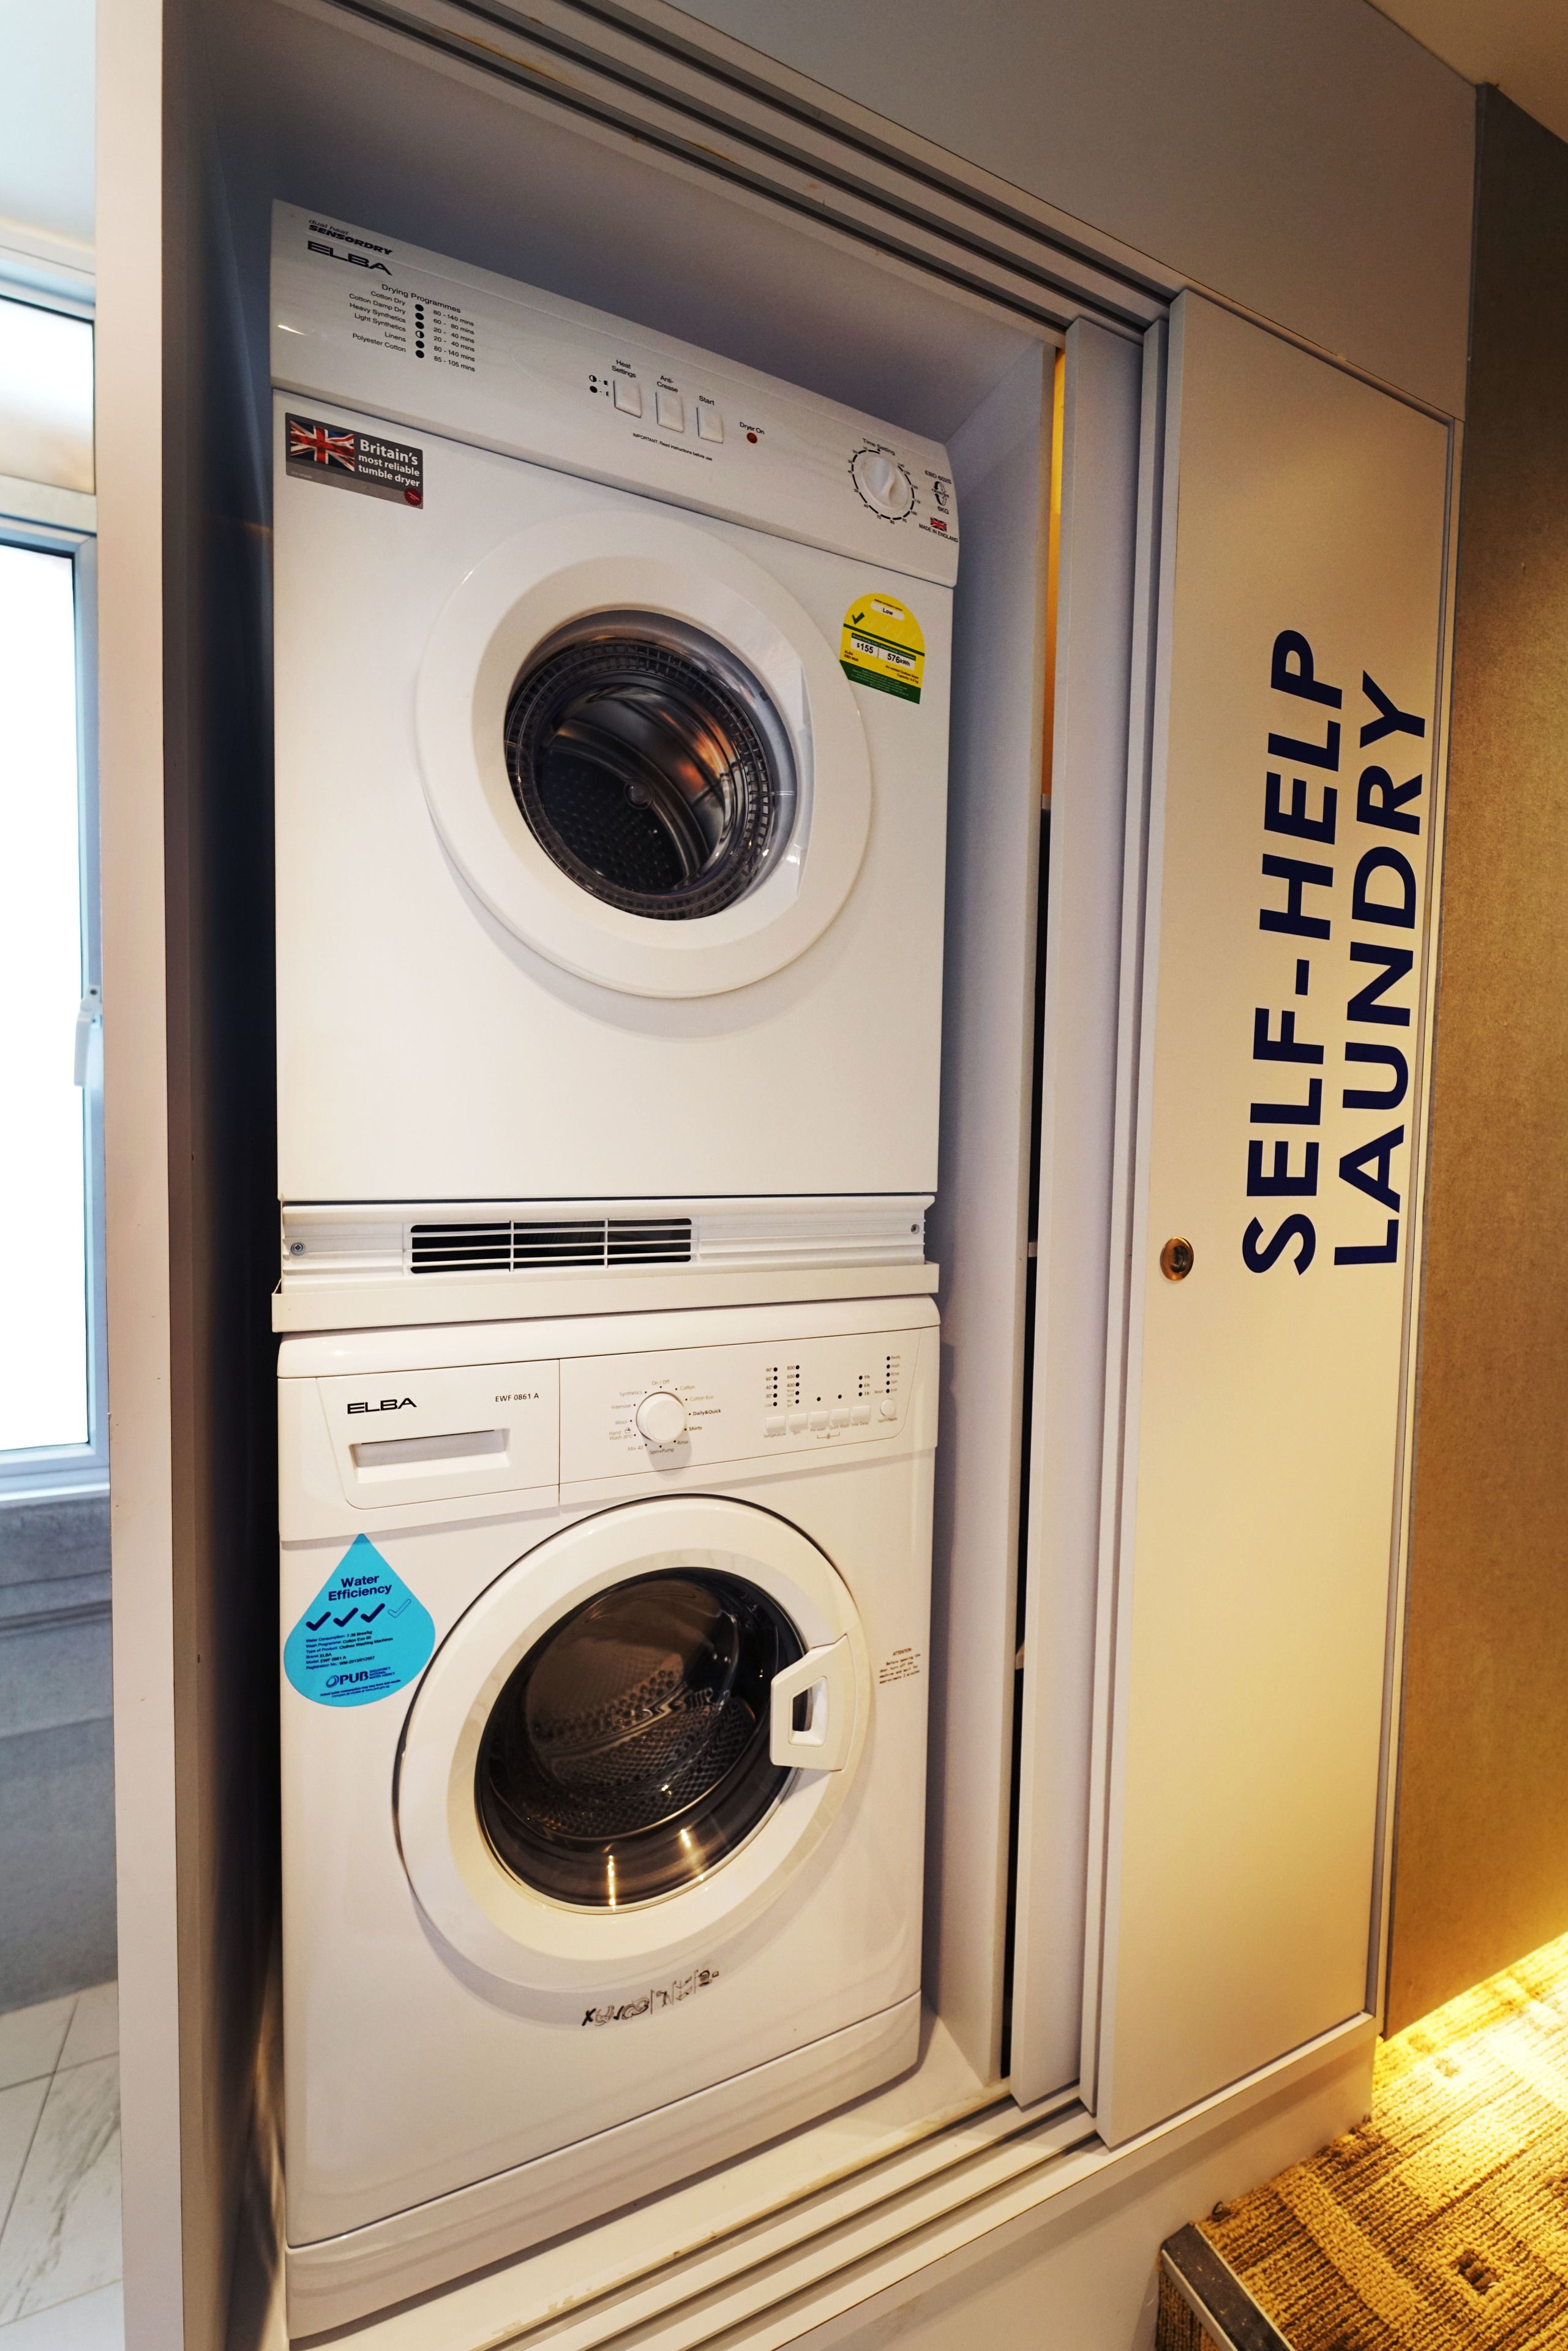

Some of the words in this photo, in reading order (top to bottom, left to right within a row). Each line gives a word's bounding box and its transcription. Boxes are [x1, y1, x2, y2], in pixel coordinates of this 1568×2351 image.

[309, 219, 328, 228] dual
[329, 225, 348, 234] heat
[309, 225, 393, 255] SENSORDRY
[307, 241, 392, 276] ELBA
[350, 294, 371, 304] Cotton
[373, 301, 392, 310] Damp
[371, 291, 392, 301] Cotton
[382, 284, 408, 298] Drying
[410, 293, 461, 313] Programmes
[350, 302, 370, 313] Heavy
[373, 309, 406, 323] Synthetics
[354, 313, 370, 322] Light
[373, 318, 406, 332] Synthetics
[353, 333, 383, 345] Polyester
[384, 342, 406, 352] Cotton
[384, 331, 406, 342] Linens
[612, 366, 637, 378] Settings
[616, 359, 631, 369] Heat
[656, 381, 678, 393] Crease
[660, 375, 674, 383] Anti-
[699, 396, 715, 406] Start
[740, 421, 755, 432] Dryer
[670, 445, 692, 454] instructions
[862, 438, 876, 447] Time
[877, 444, 895, 456] Setting
[359, 455, 382, 467] most
[384, 462, 420, 477] reliable
[358, 465, 392, 480] tumble
[395, 474, 420, 487] dryer
[937, 506, 949, 514] 6KG
[919, 523, 931, 533] MADE
[938, 531, 958, 542] ENGLAND
[1242, 629, 1342, 1275] SELF-HELP
[1334, 670, 1425, 1266] LAUNDRY
[347, 1398, 417, 1414] ELBA
[341, 1575, 380, 1588] Water
[328, 1584, 392, 1602] Efficiency
[340, 1671, 369, 1685] PUB
